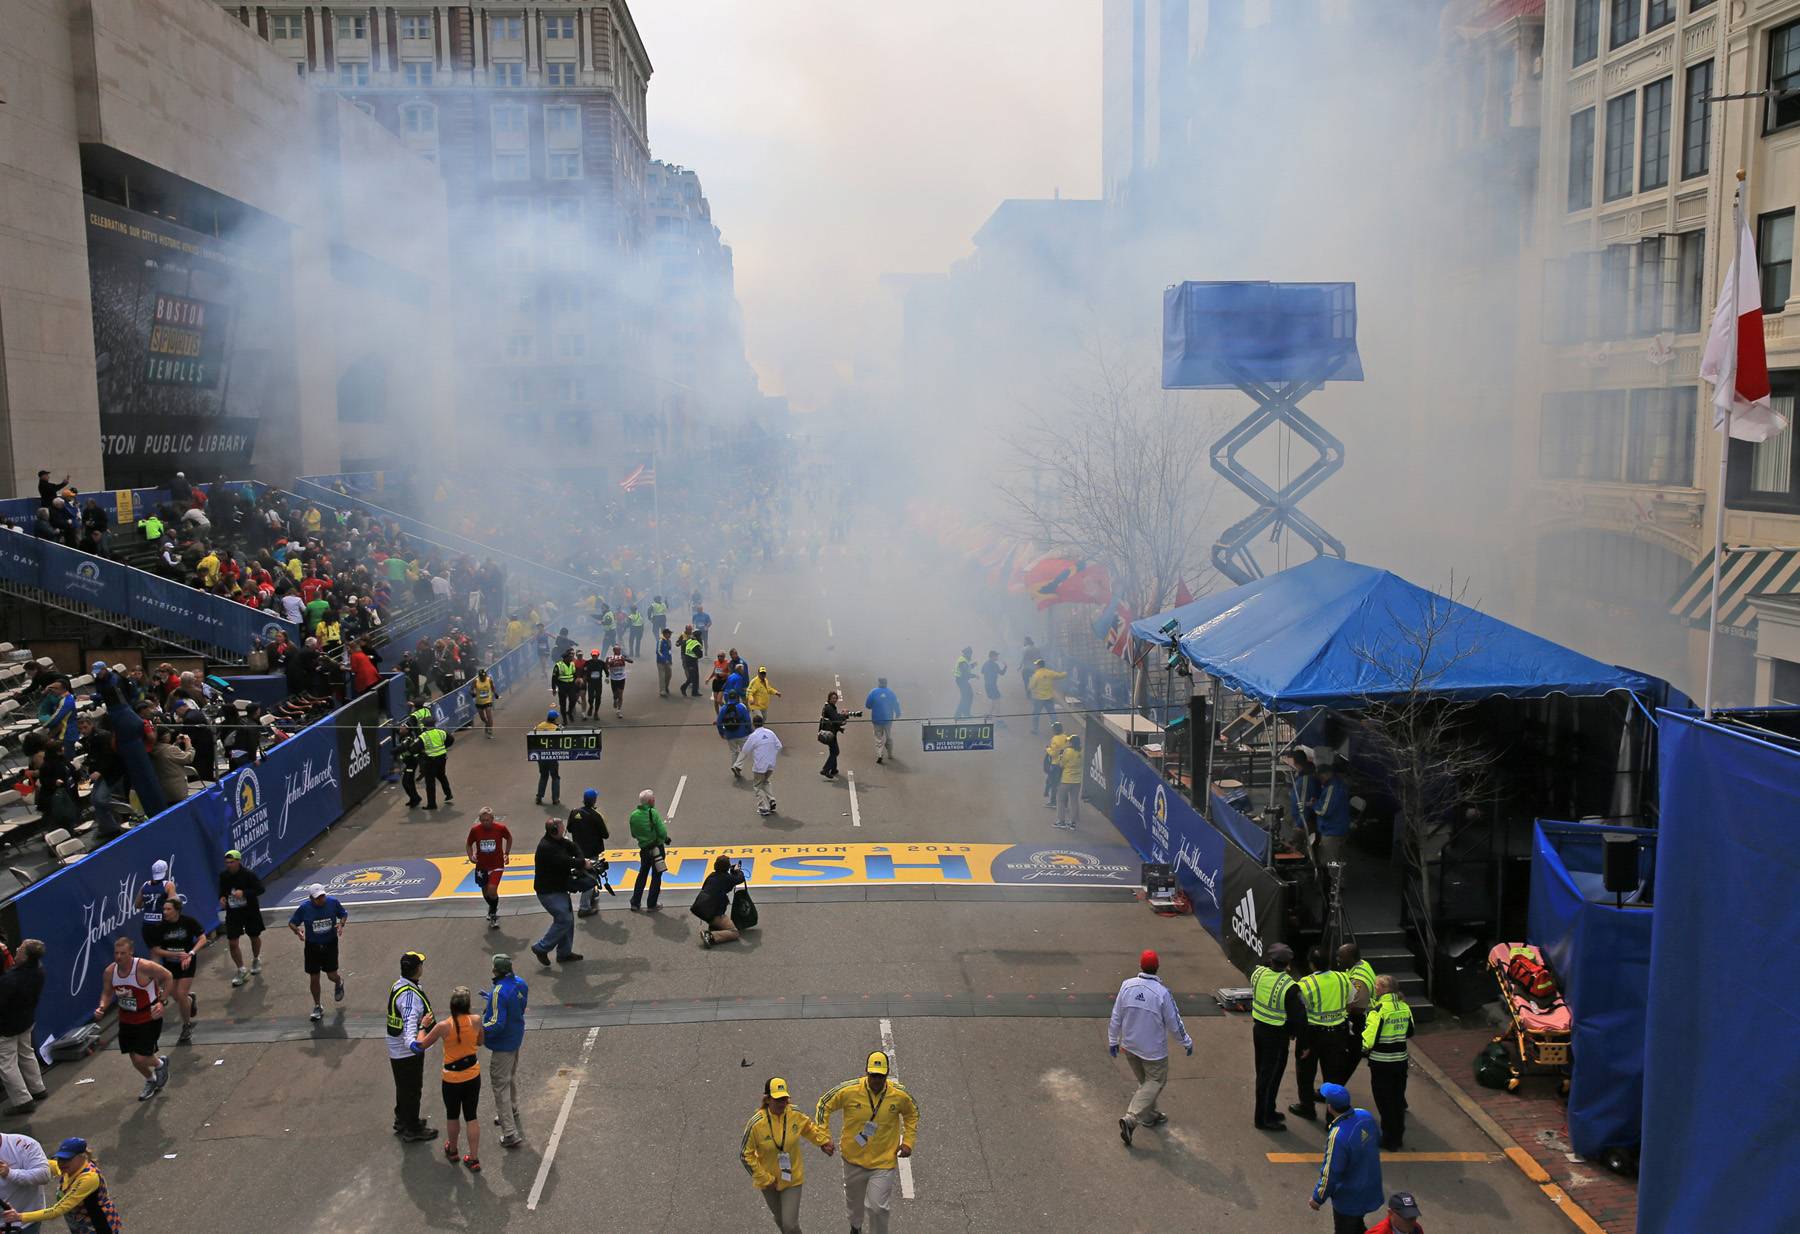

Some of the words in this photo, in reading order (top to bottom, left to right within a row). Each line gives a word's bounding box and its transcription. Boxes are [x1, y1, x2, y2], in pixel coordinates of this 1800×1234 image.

[90, 213, 128, 235] CELEBRATING
[129, 225, 140, 239] OUR
[156, 298, 204, 326] BOSTON
[148, 359, 205, 383] TEMPLES
[100, 435, 136, 455] STON
[144, 434, 193, 454] PUBLIC
[199, 434, 248, 452] LIBRARY
[13, 554, 33, 567] DAY
[141, 595, 194, 617] PATRIOTS'
[197, 613, 218, 627] DAY
[540, 736, 597, 749] 4:10:10
[348, 751, 371, 778] adidas
[279, 771, 302, 839] John
[301, 749, 338, 795] Hancock
[244, 807, 268, 832] BOSTON
[234, 820, 270, 851] MARATHON
[703, 846, 849, 855] MARATHON
[349, 878, 423, 888] MARATHON
[453, 854, 973, 893] FNISH
[71, 896, 117, 997] John
[1231, 915, 1263, 958] adidas
